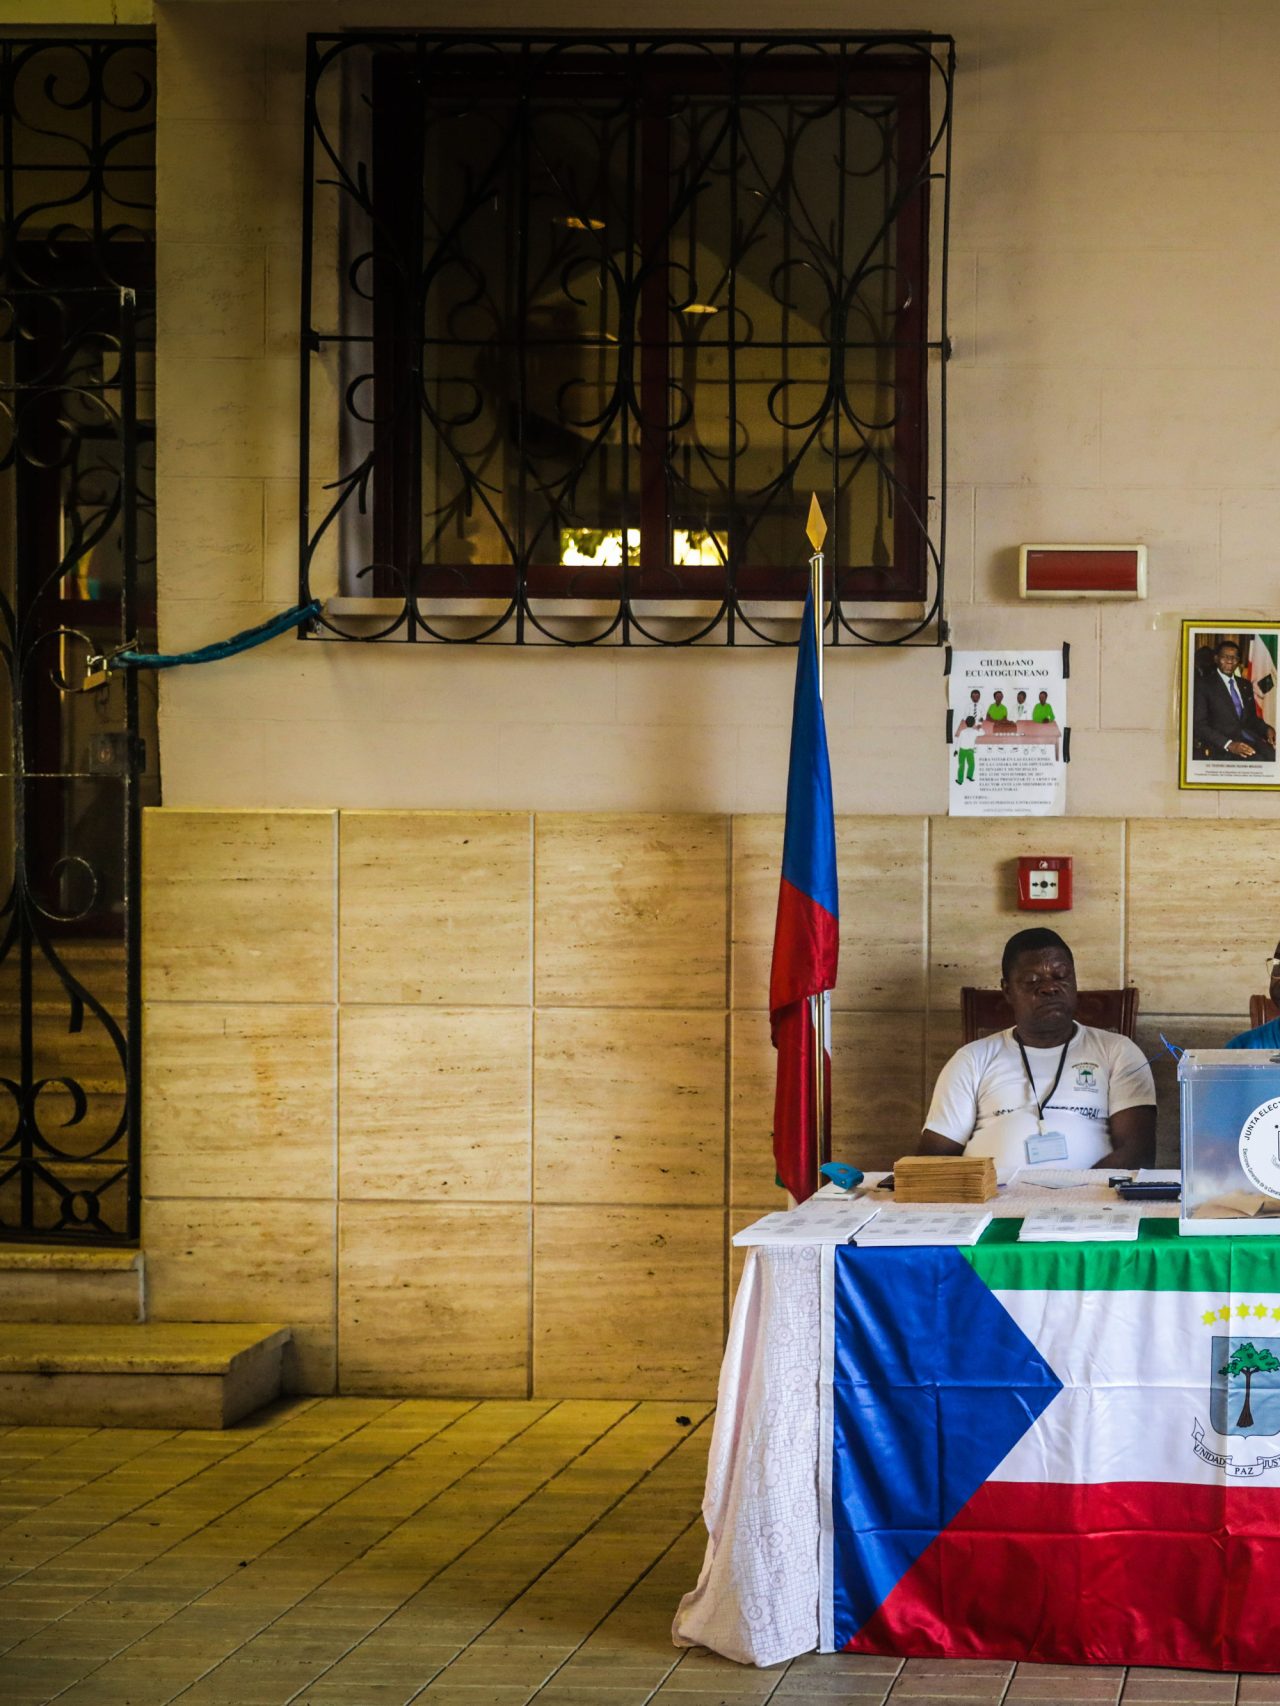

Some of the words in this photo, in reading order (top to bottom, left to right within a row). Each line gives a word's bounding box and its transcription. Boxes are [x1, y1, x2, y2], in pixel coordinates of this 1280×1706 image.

[965, 669, 1049, 677] ECUATOGUINEANO
[1244, 1115, 1260, 1141] JUNTA
[1194, 1443, 1226, 1466] UNIDAD
[1234, 1467, 1254, 1475] PAZ
